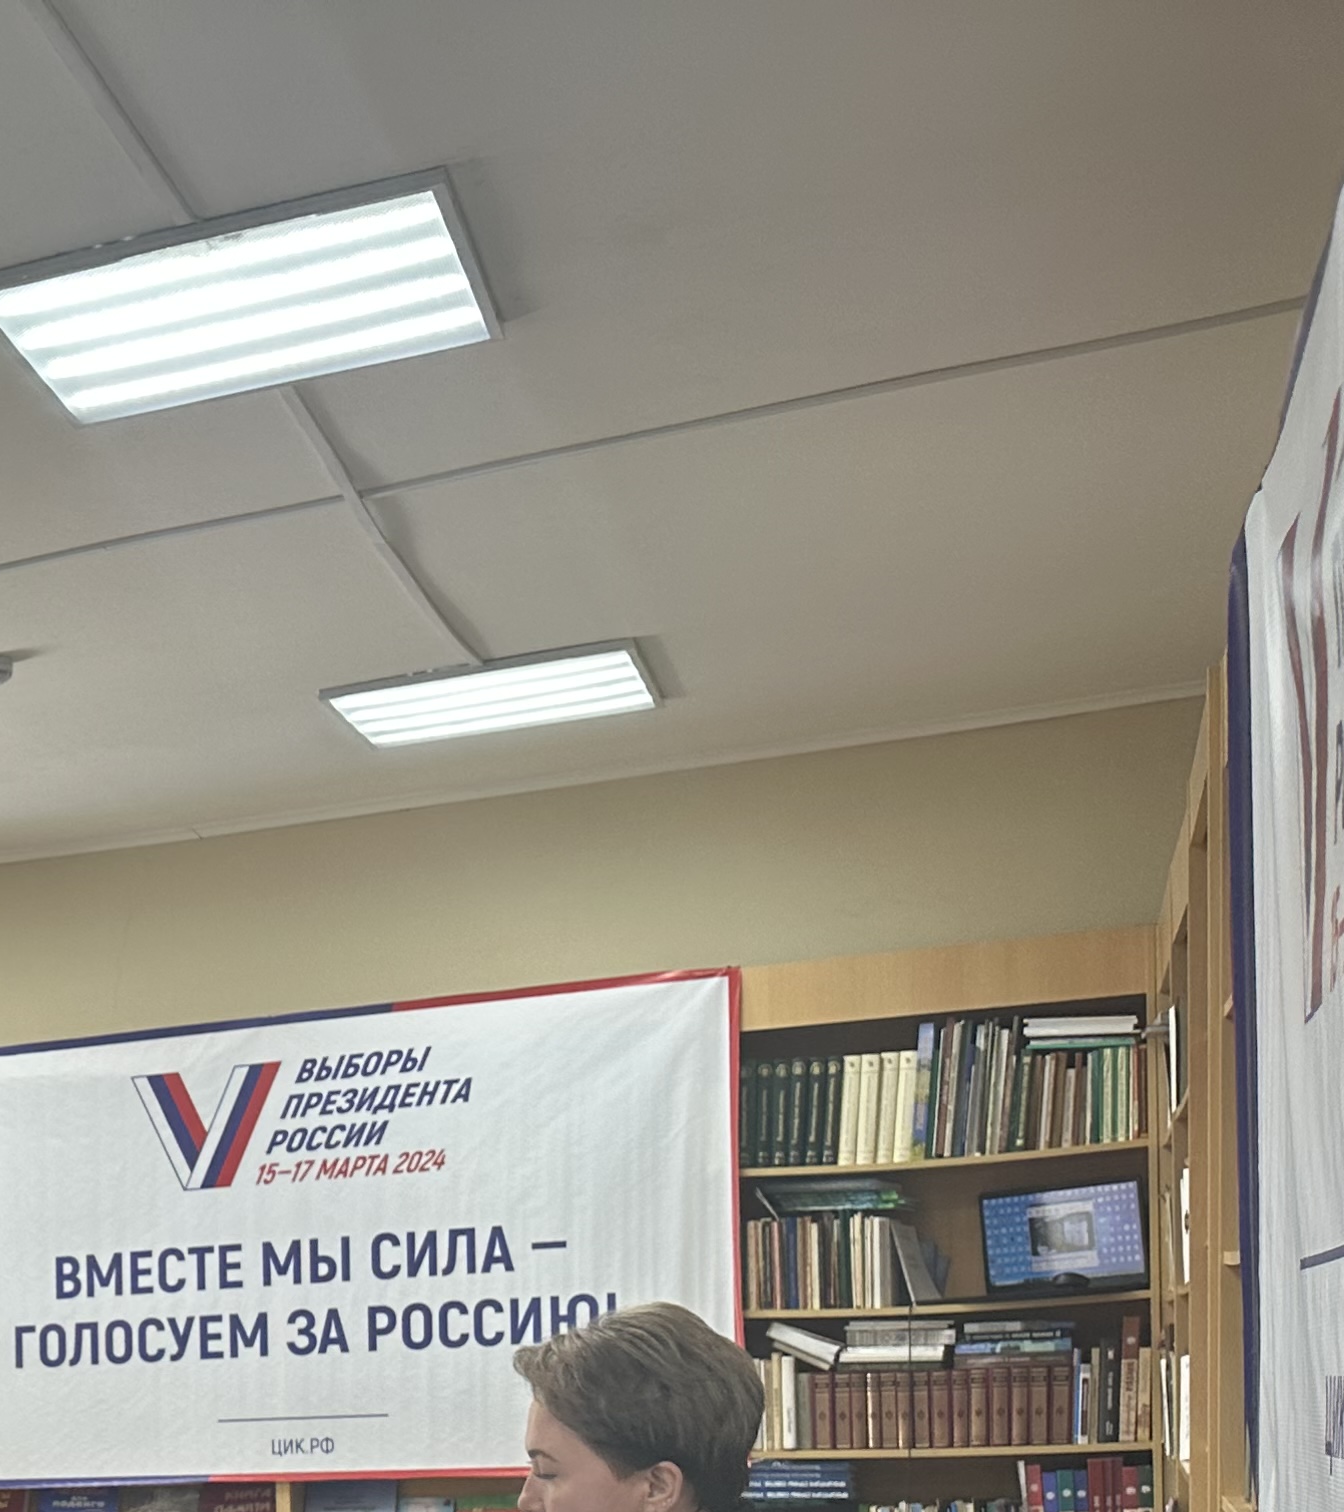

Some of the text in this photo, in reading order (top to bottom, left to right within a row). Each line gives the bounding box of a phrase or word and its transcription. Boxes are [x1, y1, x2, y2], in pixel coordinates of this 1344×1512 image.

[294, 1045, 432, 1084] ВЫБОРЫ
[279, 1077, 473, 1119] ПРЕЗИДЕНТА
[265, 1120, 389, 1155] РОССИИ
[315, 1153, 389, 1181] МАРТА
[392, 1148, 446, 1175] 2024
[55, 1243, 244, 1300] ВМЕСТЕ
[261, 1236, 351, 1287] МЫ
[370, 1225, 515, 1280] СИЛА
[14, 1311, 269, 1369] ГОЛОСУЕМ
[286, 1307, 350, 1356] ЗА
[271, 1436, 335, 1458] ЦИК.РФ
